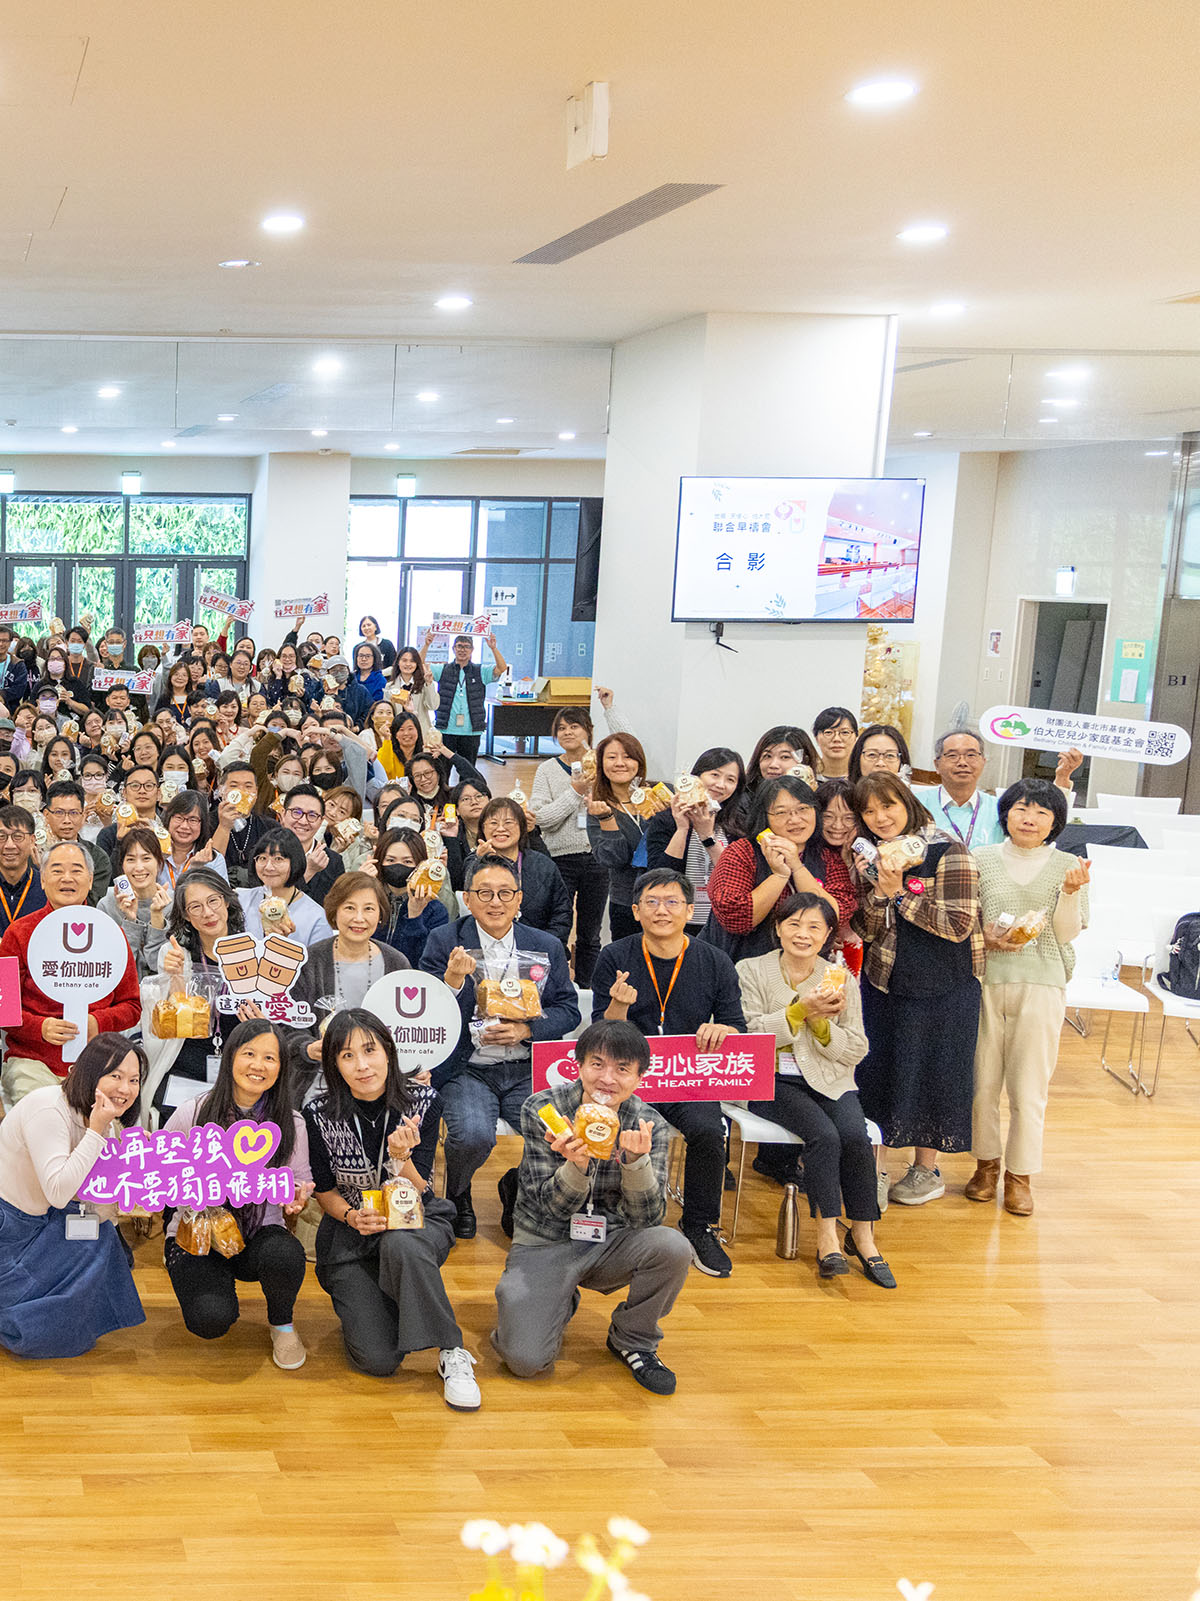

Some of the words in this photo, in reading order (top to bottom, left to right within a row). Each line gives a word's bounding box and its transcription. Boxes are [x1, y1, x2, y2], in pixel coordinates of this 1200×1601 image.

[713, 521, 772, 533] 聯合早禱會
[716, 552, 766, 572] 合影
[283, 599, 327, 615] 只想有家
[143, 626, 190, 641] 只想有家
[441, 619, 489, 634] 只想有家
[1167, 675, 1188, 687] B1
[1033, 726, 1146, 749] 伯大尼兒少家庭基金會
[41, 960, 113, 979] 愛你咖啡
[53, 981, 82, 989] Bethany
[84, 981, 100, 989] cafe
[384, 1024, 447, 1045] 你咖啡
[418, 1047, 435, 1055] cafe
[643, 1051, 756, 1078] 使心家族
[657, 1078, 704, 1089] HEART
[708, 1077, 754, 1088] FAMILY
[82, 1165, 289, 1208] 也不要獨自飛翔
